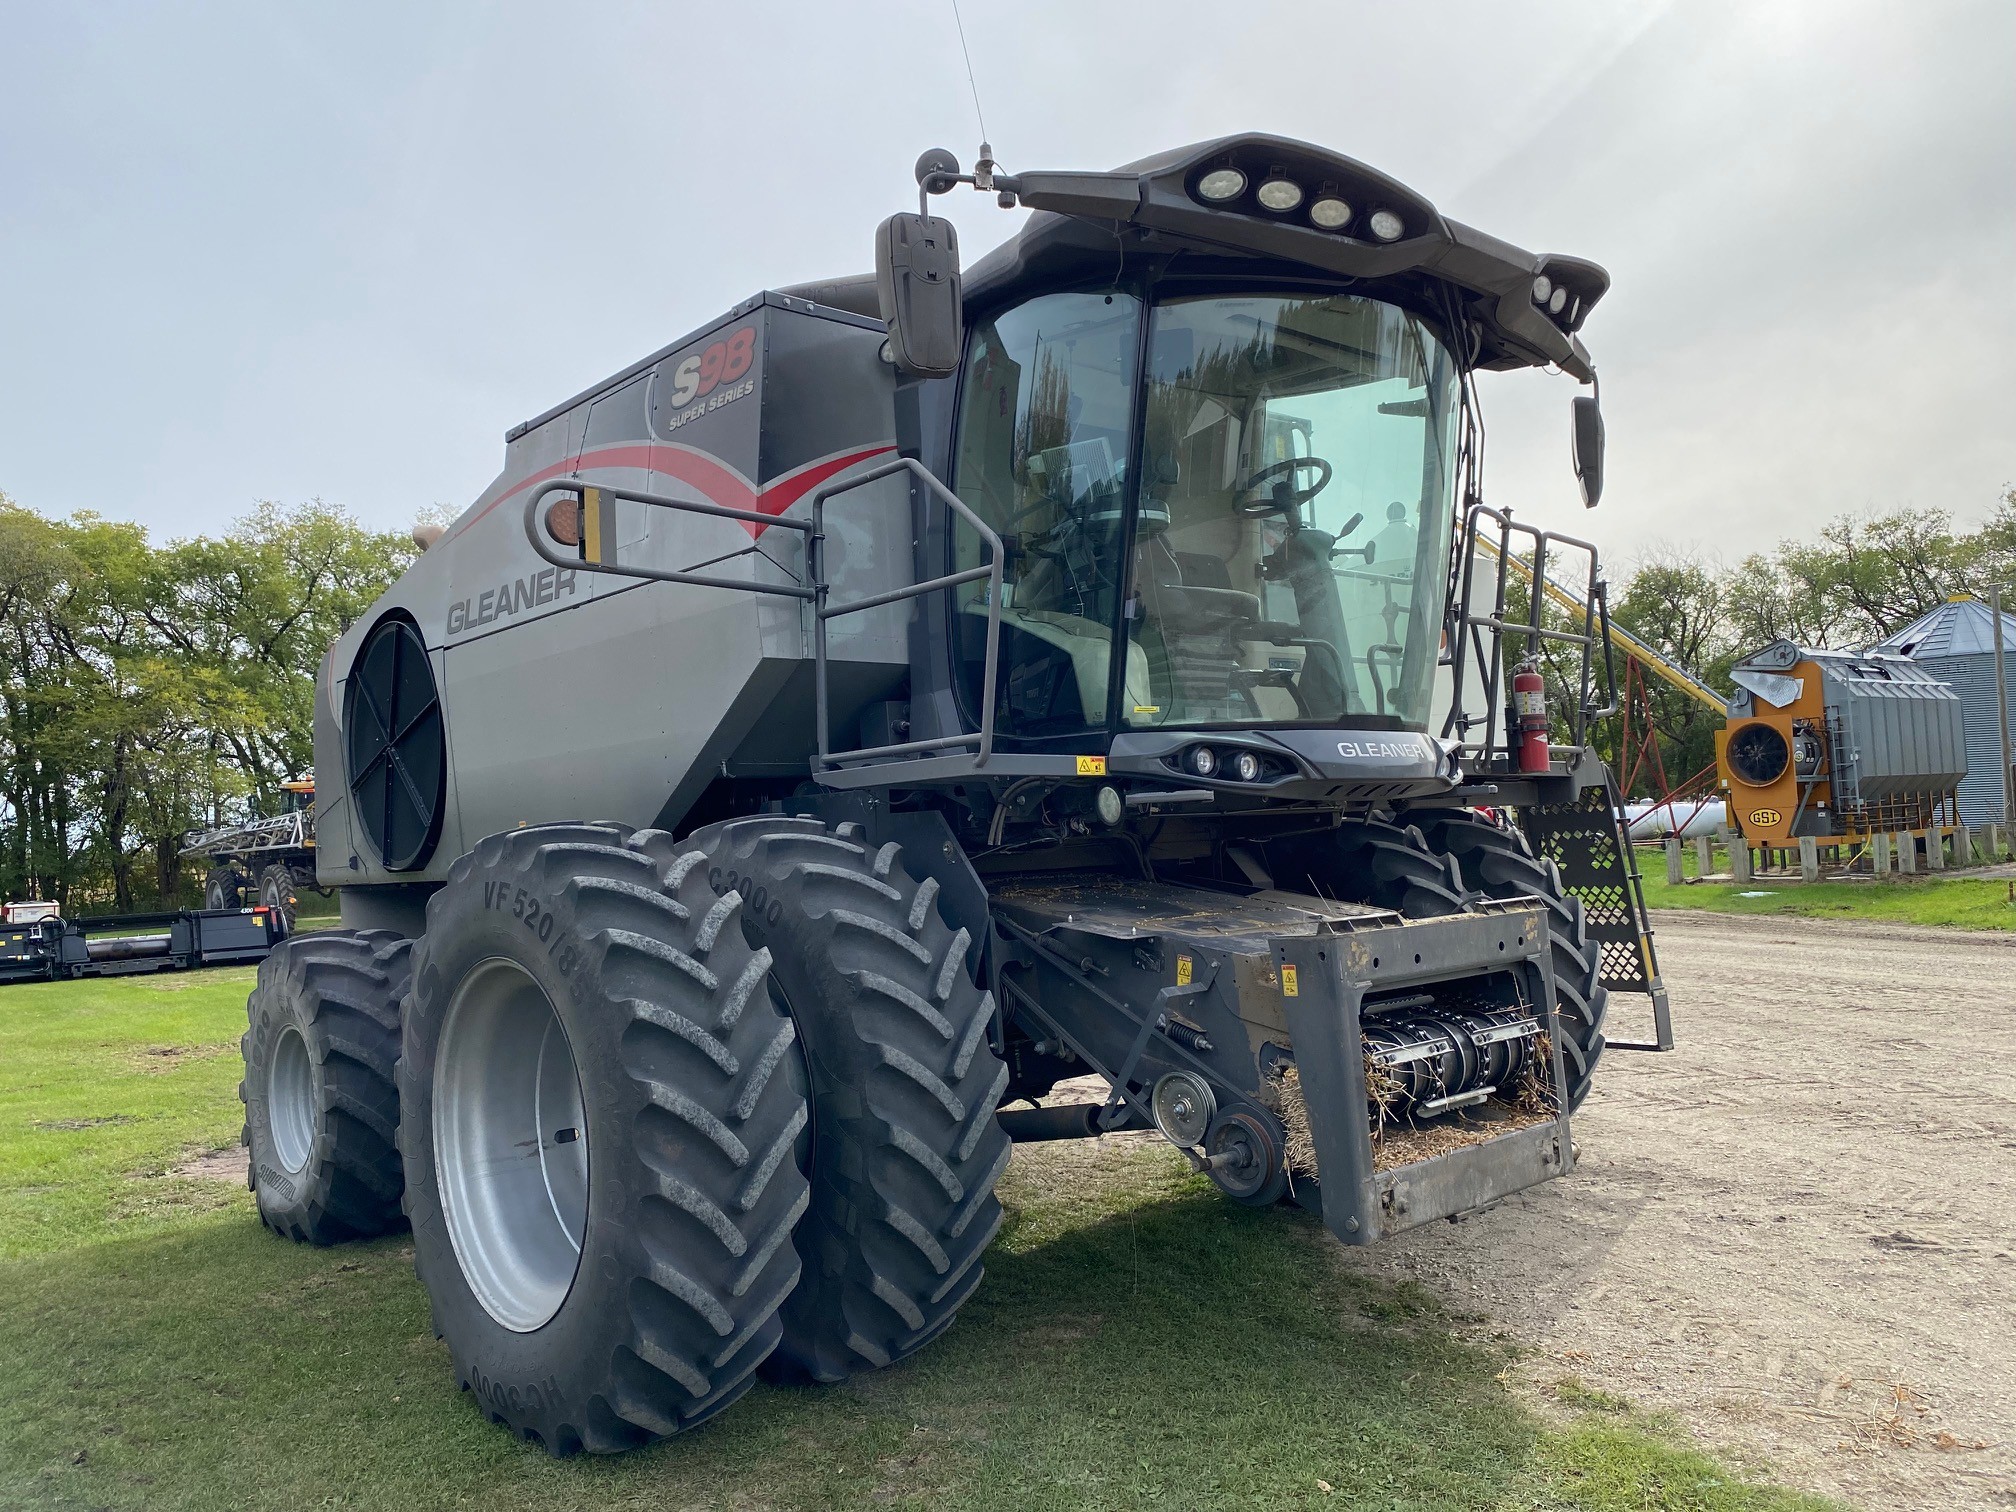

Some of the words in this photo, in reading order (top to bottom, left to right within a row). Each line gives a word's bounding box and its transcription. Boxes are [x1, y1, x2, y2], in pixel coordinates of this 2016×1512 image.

[671, 326, 757, 410] S98
[669, 402, 706, 432] SUPER
[708, 380, 755, 413] SERIES
[446, 566, 577, 635] GLEANER
[1337, 742, 1425, 759] GLEANER
[1753, 811, 1777, 823] GSI
[484, 880, 511, 910] VF
